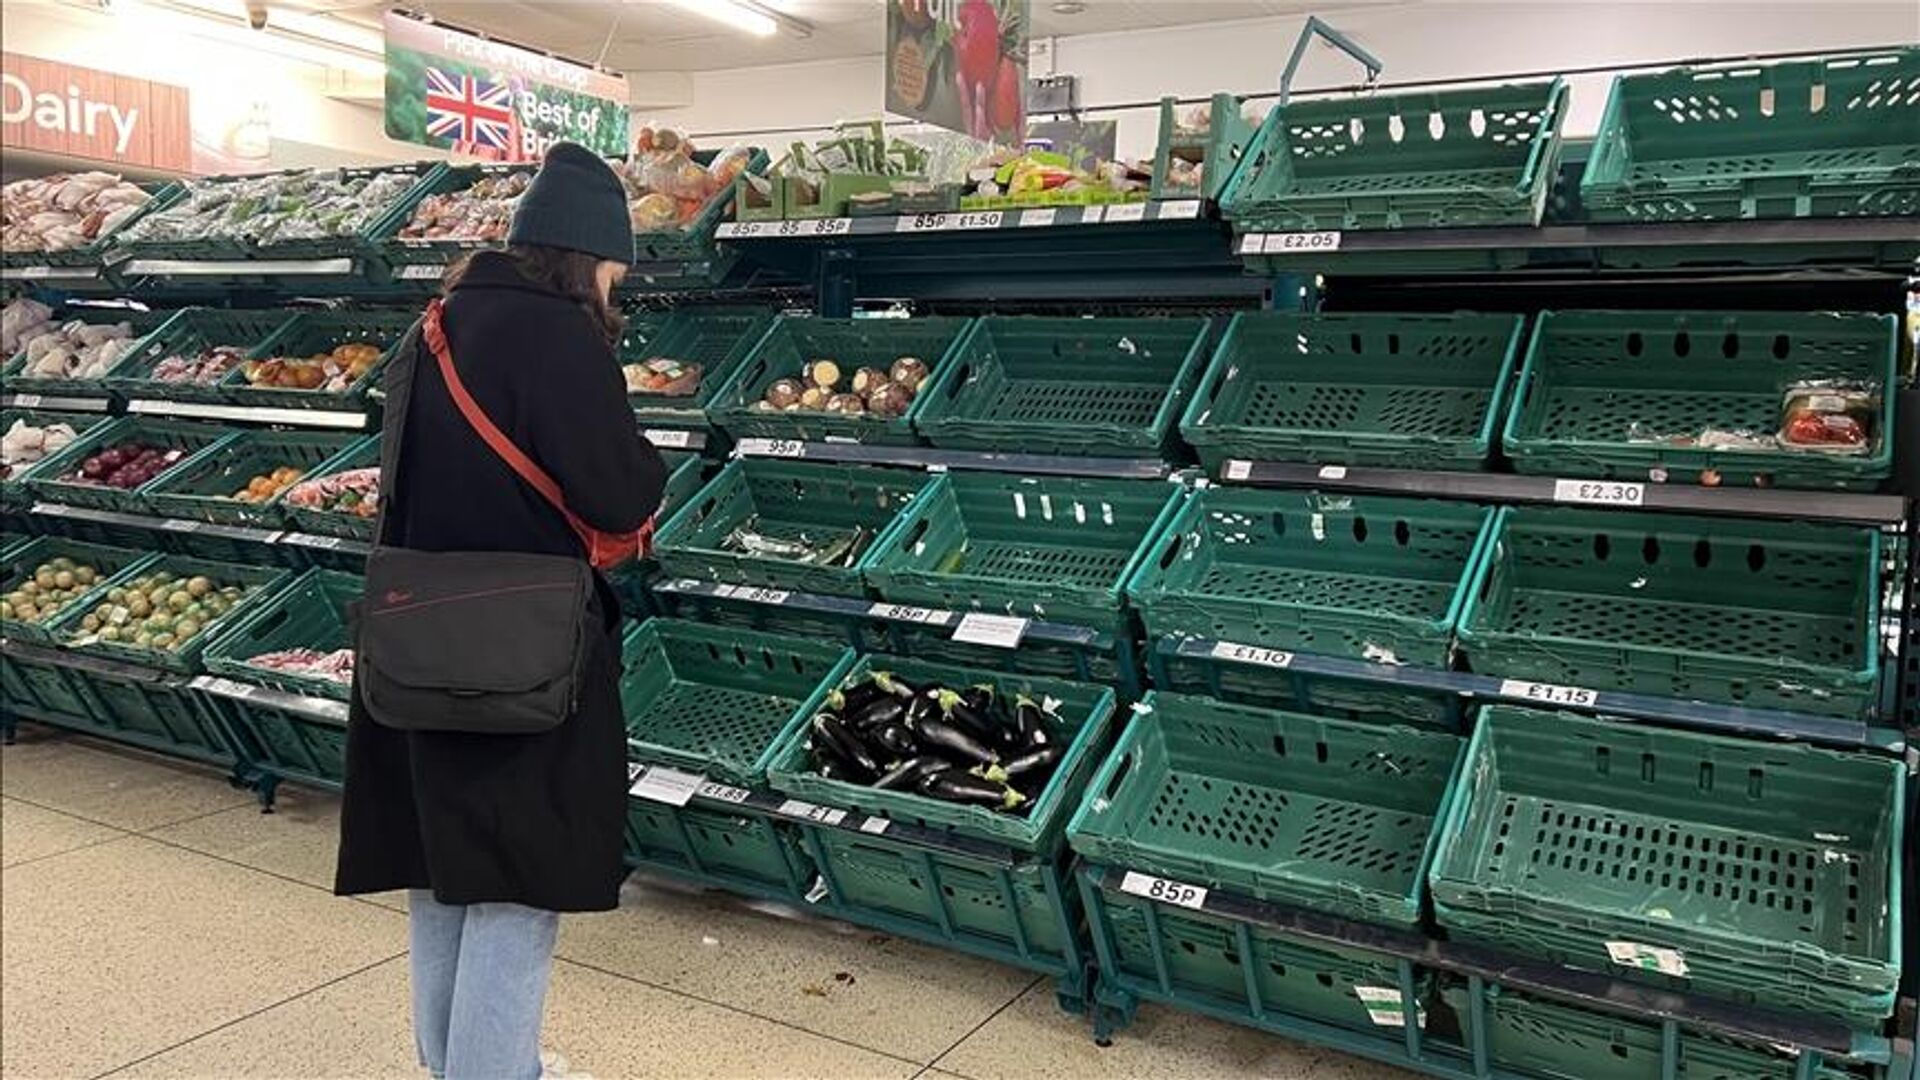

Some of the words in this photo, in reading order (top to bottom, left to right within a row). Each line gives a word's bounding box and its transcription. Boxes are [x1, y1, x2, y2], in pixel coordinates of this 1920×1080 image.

[3, 73, 139, 153] Dairy
[524, 91, 573, 128] Best
[577, 106, 601, 138] of
[959, 213, 999, 226] £1.50
[1284, 233, 1334, 248] £2.05
[1579, 484, 1639, 501] £2.30
[1234, 646, 1286, 664] £1.10
[1527, 684, 1590, 703] £1.15
